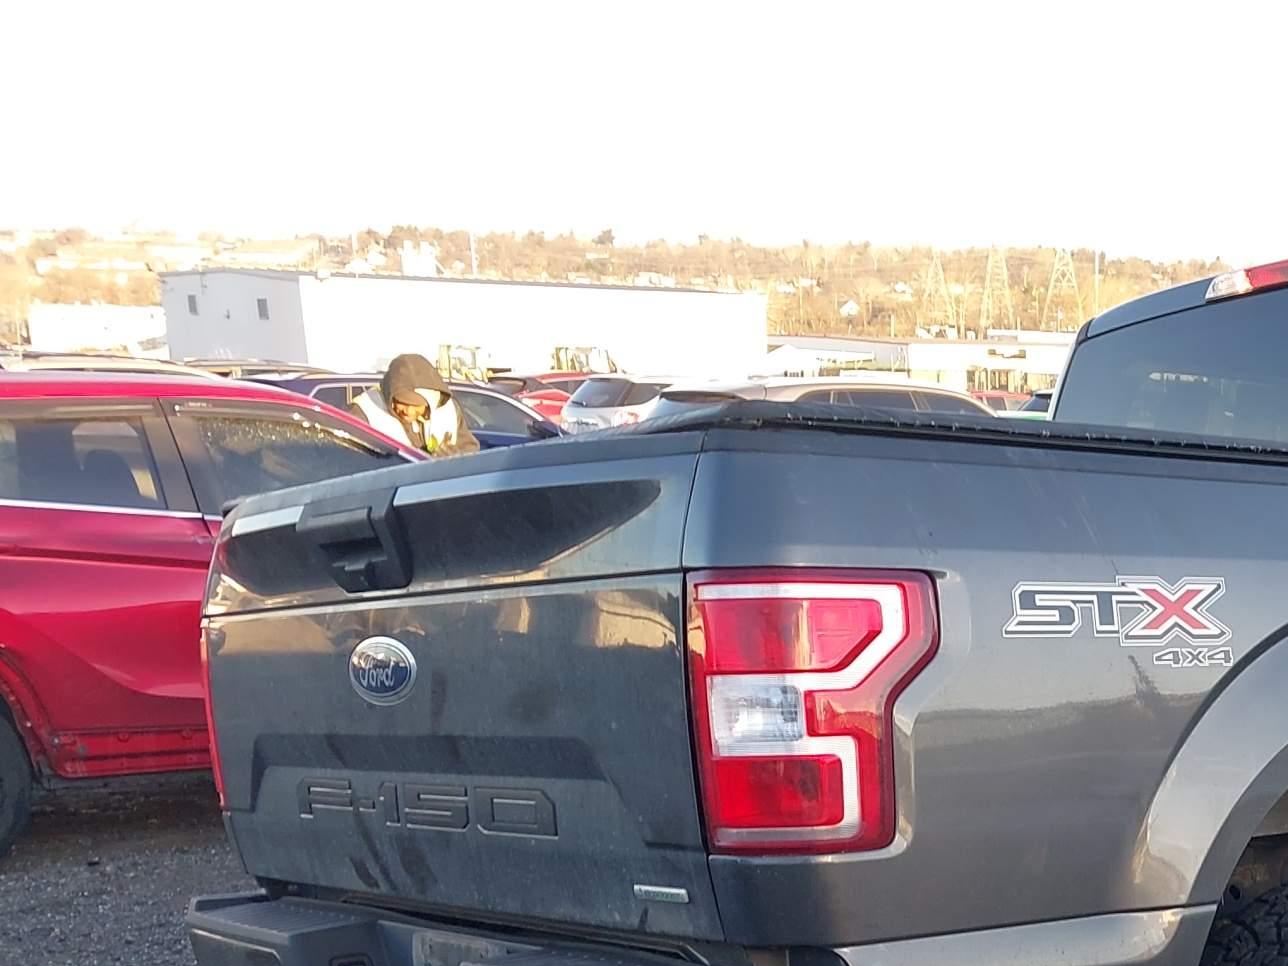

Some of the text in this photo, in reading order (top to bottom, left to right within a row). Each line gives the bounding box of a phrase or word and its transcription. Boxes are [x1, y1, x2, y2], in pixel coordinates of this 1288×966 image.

[1002, 575, 1232, 646] STX
[359, 652, 395, 688] Ford
[297, 777, 560, 840] F-150
